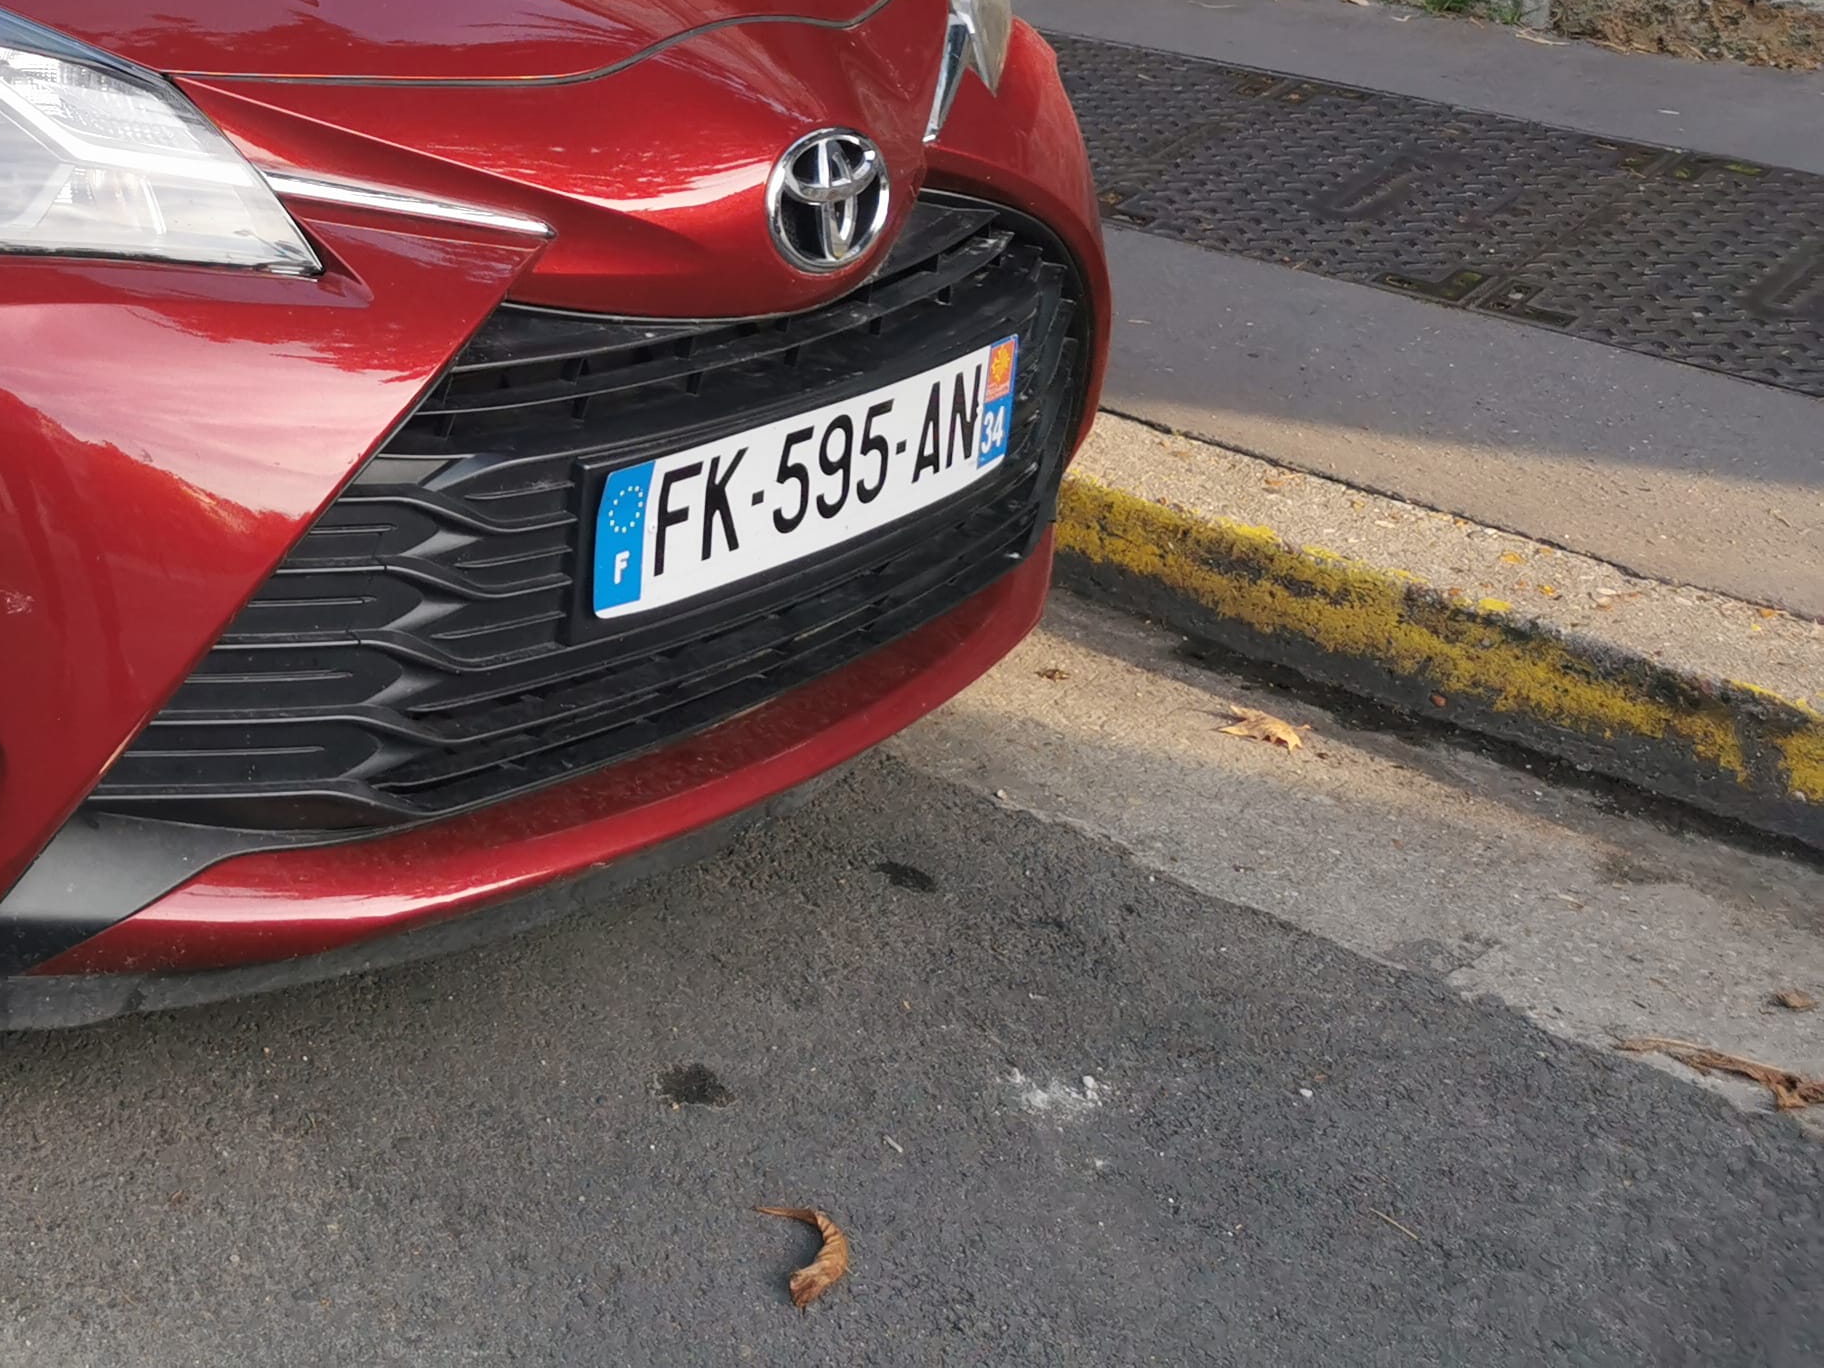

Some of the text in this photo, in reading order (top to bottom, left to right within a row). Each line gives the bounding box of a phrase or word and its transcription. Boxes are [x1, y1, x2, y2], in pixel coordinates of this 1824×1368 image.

[981, 405, 1005, 454] 34
[654, 362, 984, 577] FK-595-AN
[613, 550, 631, 585] F
